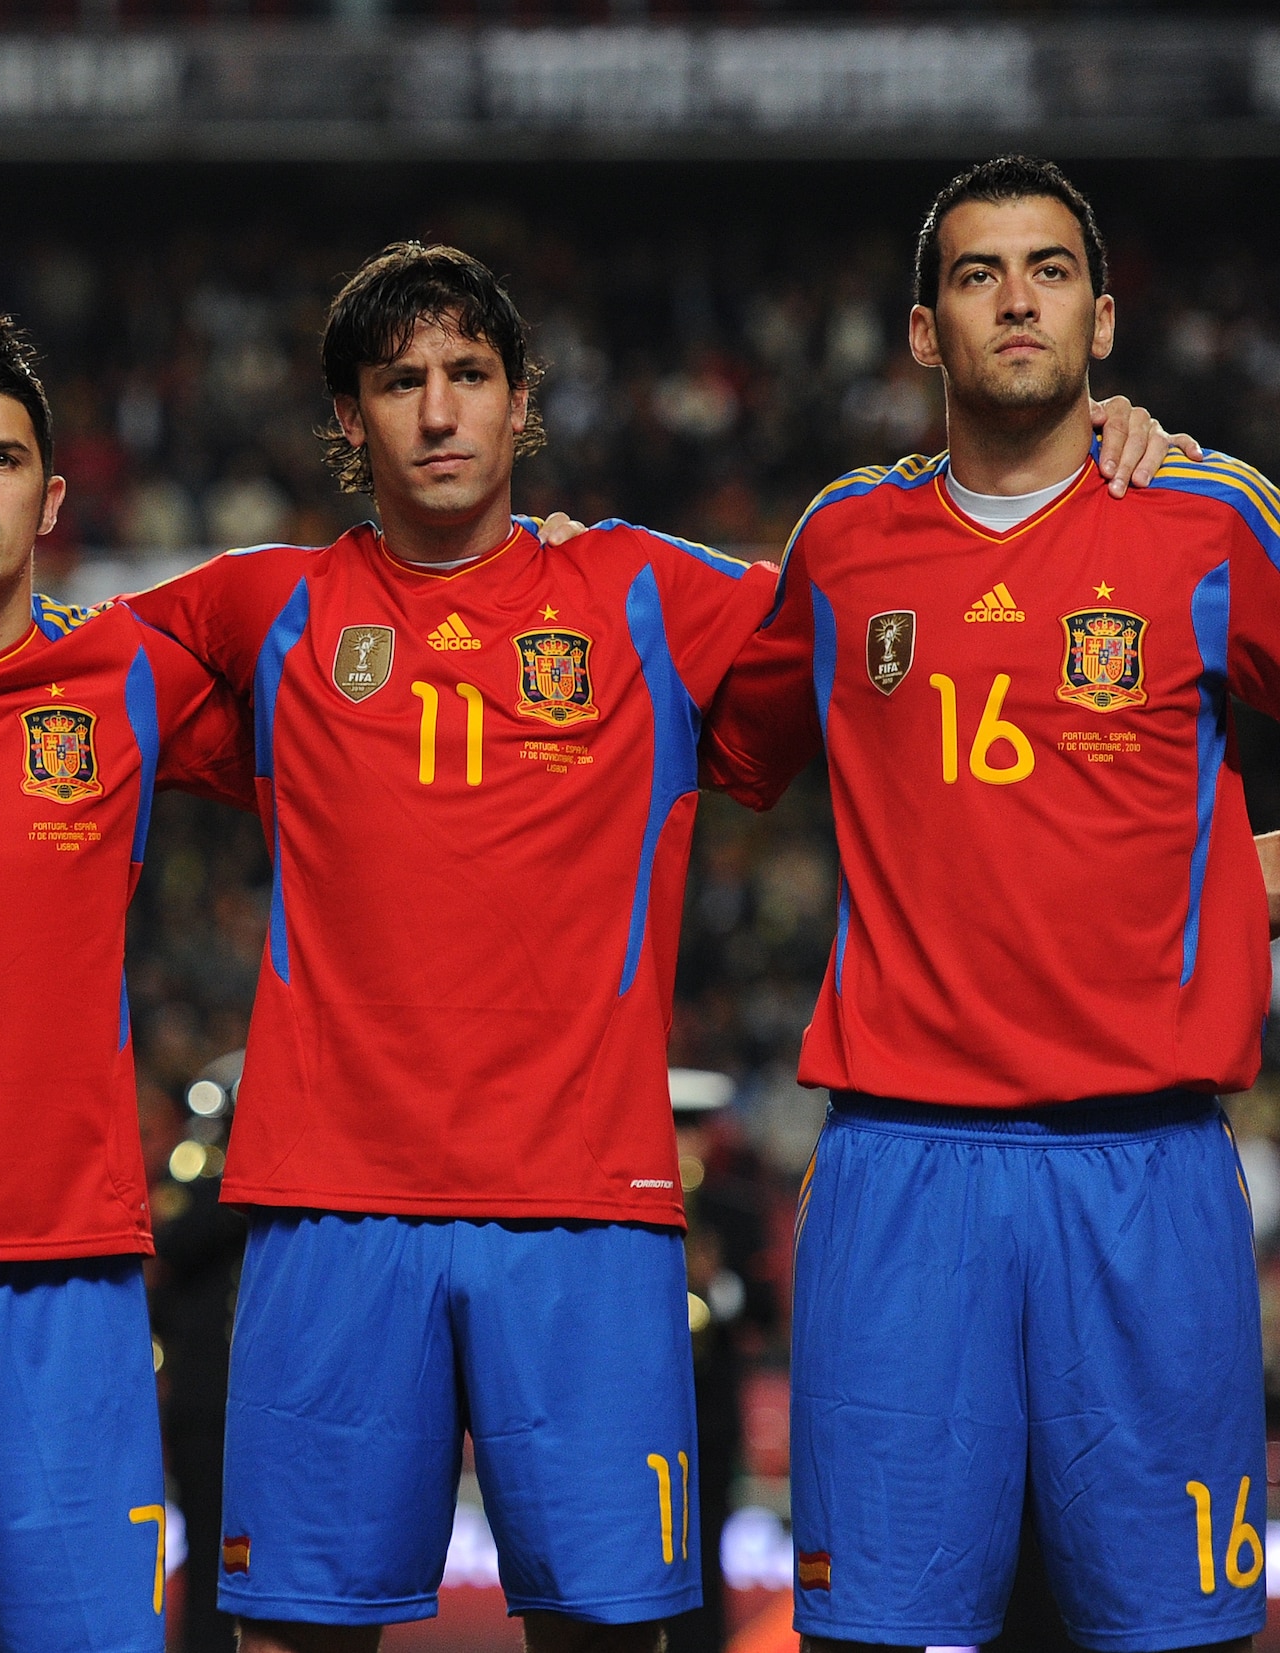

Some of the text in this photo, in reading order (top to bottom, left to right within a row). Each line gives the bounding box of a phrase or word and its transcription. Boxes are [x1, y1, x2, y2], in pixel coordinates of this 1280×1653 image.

[964, 607, 1026, 623] adidas
[878, 661, 899, 675] FIFA
[349, 672, 372, 682] FIFA
[411, 681, 484, 786] 11
[929, 673, 1035, 785] 16
[1062, 731, 1102, 741] PORTUGAL
[1109, 731, 1137, 741] ESPAÑA
[524, 741, 560, 752] PORTUGAL
[1057, 742, 1141, 753] 17 DE NOVIEMBRE, 2010
[519, 750, 527, 759] 17
[528, 751, 538, 760] DE
[577, 755, 594, 765] 2010
[1087, 753, 1114, 763] LISBOA
[546, 763, 568, 774] LISBOA
[33, 822, 68, 831] PORTUGAL
[28, 832, 36, 840] 17
[37, 832, 47, 840] DE
[56, 842, 80, 851] LISBOA
[647, 1451, 689, 1566] 11
[1185, 1475, 1264, 1595] 16
[129, 1504, 165, 1615] 7
